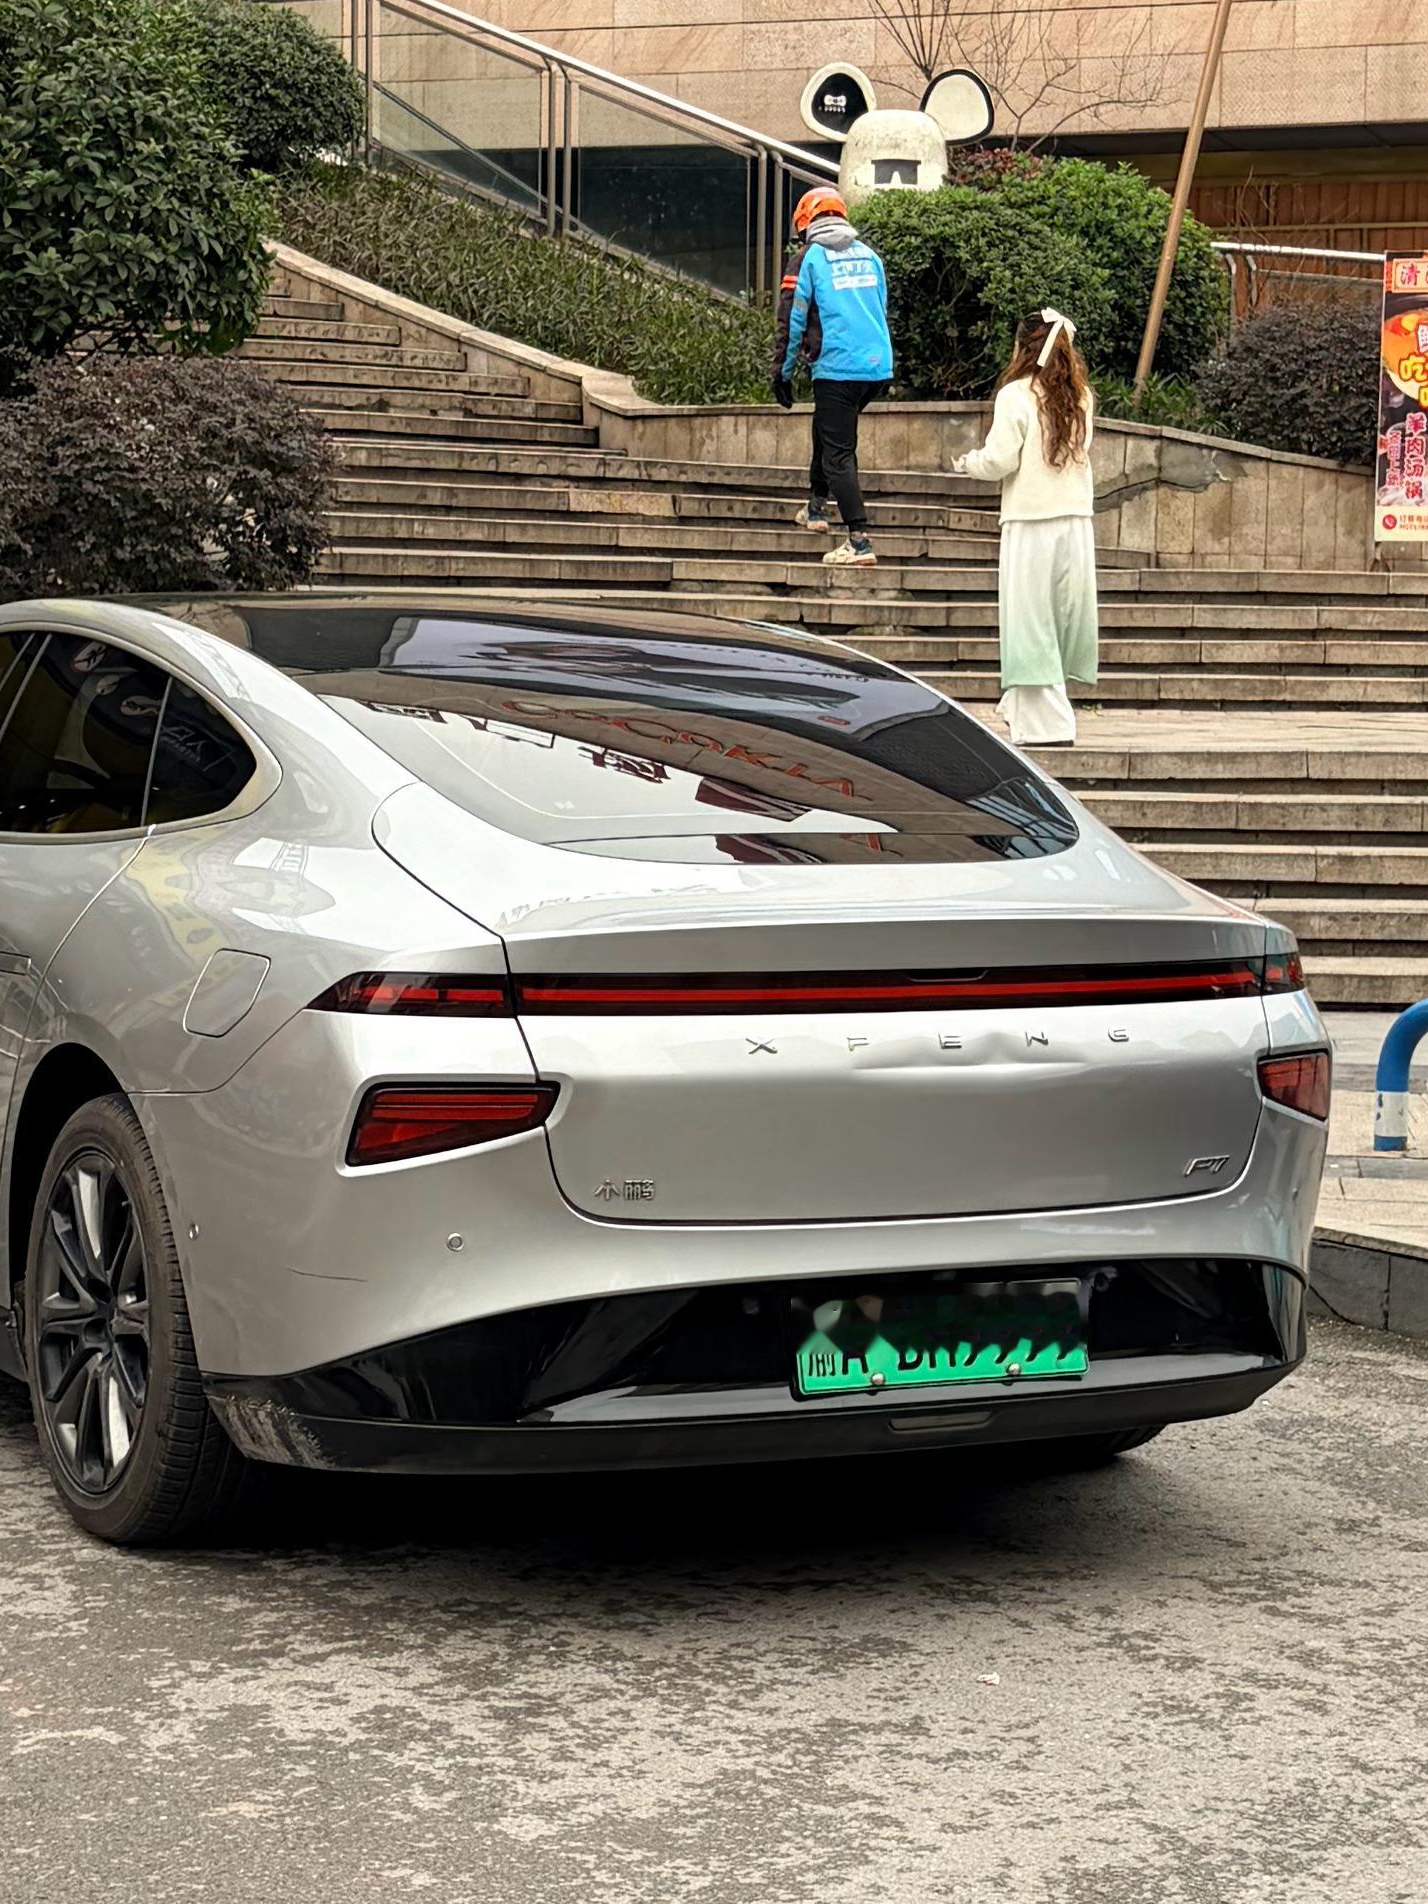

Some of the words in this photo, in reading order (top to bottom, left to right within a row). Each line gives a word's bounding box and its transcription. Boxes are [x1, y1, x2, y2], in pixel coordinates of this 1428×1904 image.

[746, 1025, 1131, 1056] XPENG
[1184, 1154, 1231, 1178] P7
[593, 1178, 657, 1202] 小鹏
